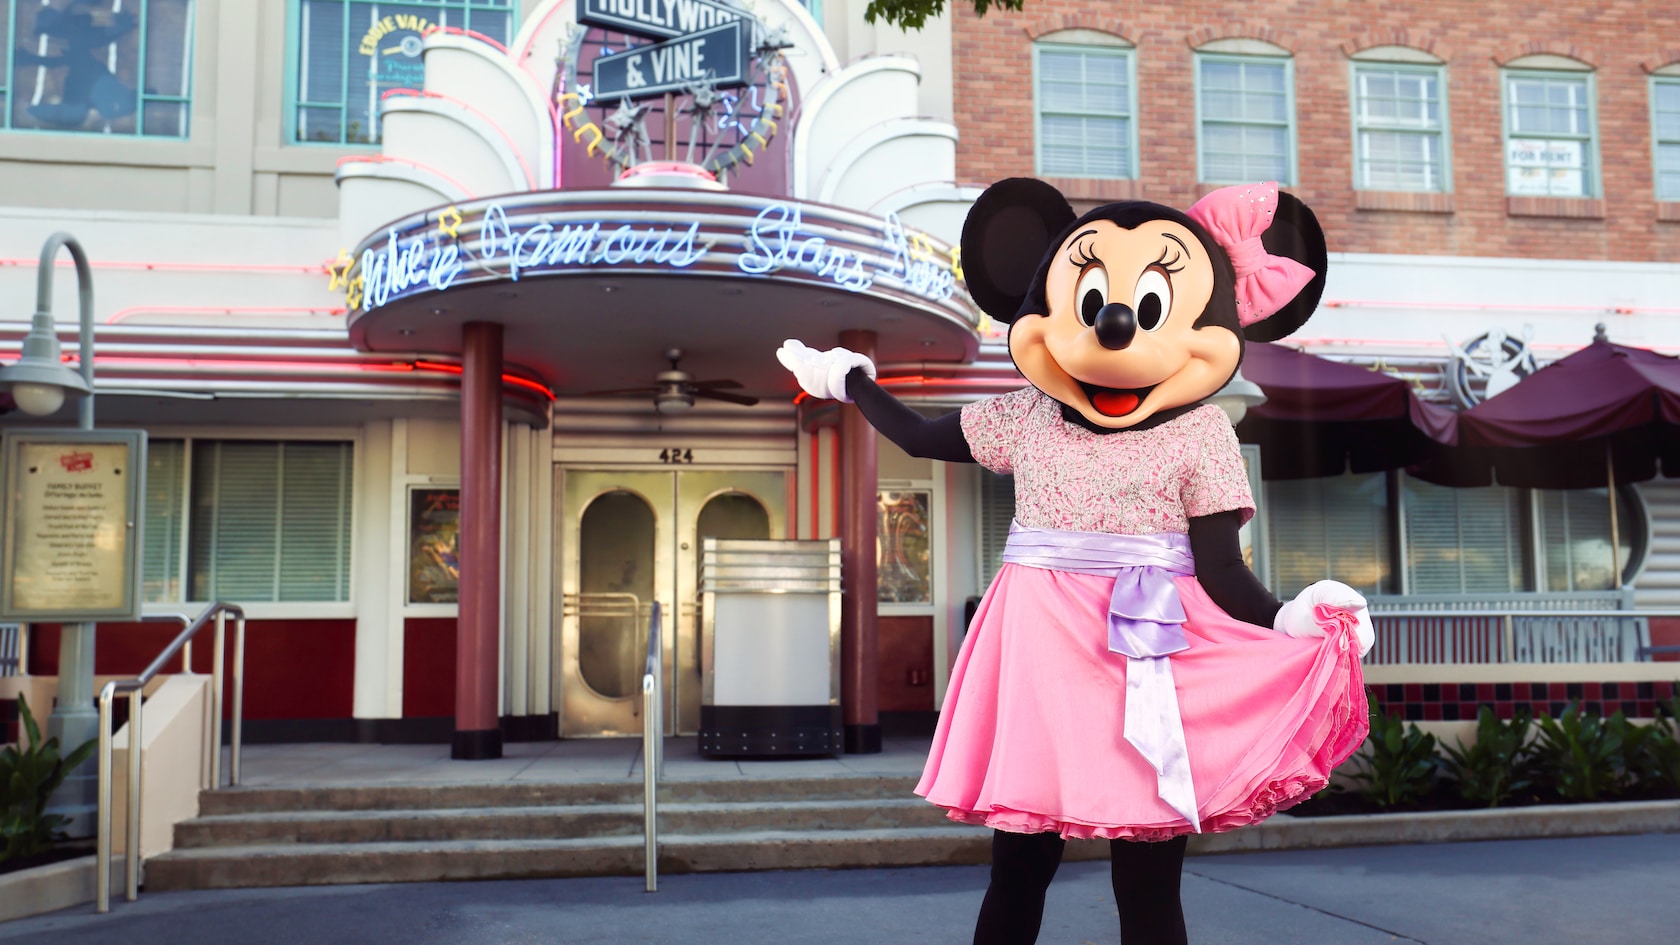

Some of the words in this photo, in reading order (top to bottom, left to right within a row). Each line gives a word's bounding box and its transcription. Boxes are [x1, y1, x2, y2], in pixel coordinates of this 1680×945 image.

[598, 0, 741, 33] OLLYWO
[359, 16, 397, 56] EDDIE
[626, 54, 647, 88] &
[651, 39, 706, 84] VINE
[1512, 151, 1535, 161] FOR
[361, 227, 463, 312] Where
[480, 204, 707, 282] Famous
[738, 203, 873, 292] Stars
[659, 447, 694, 464] 424
